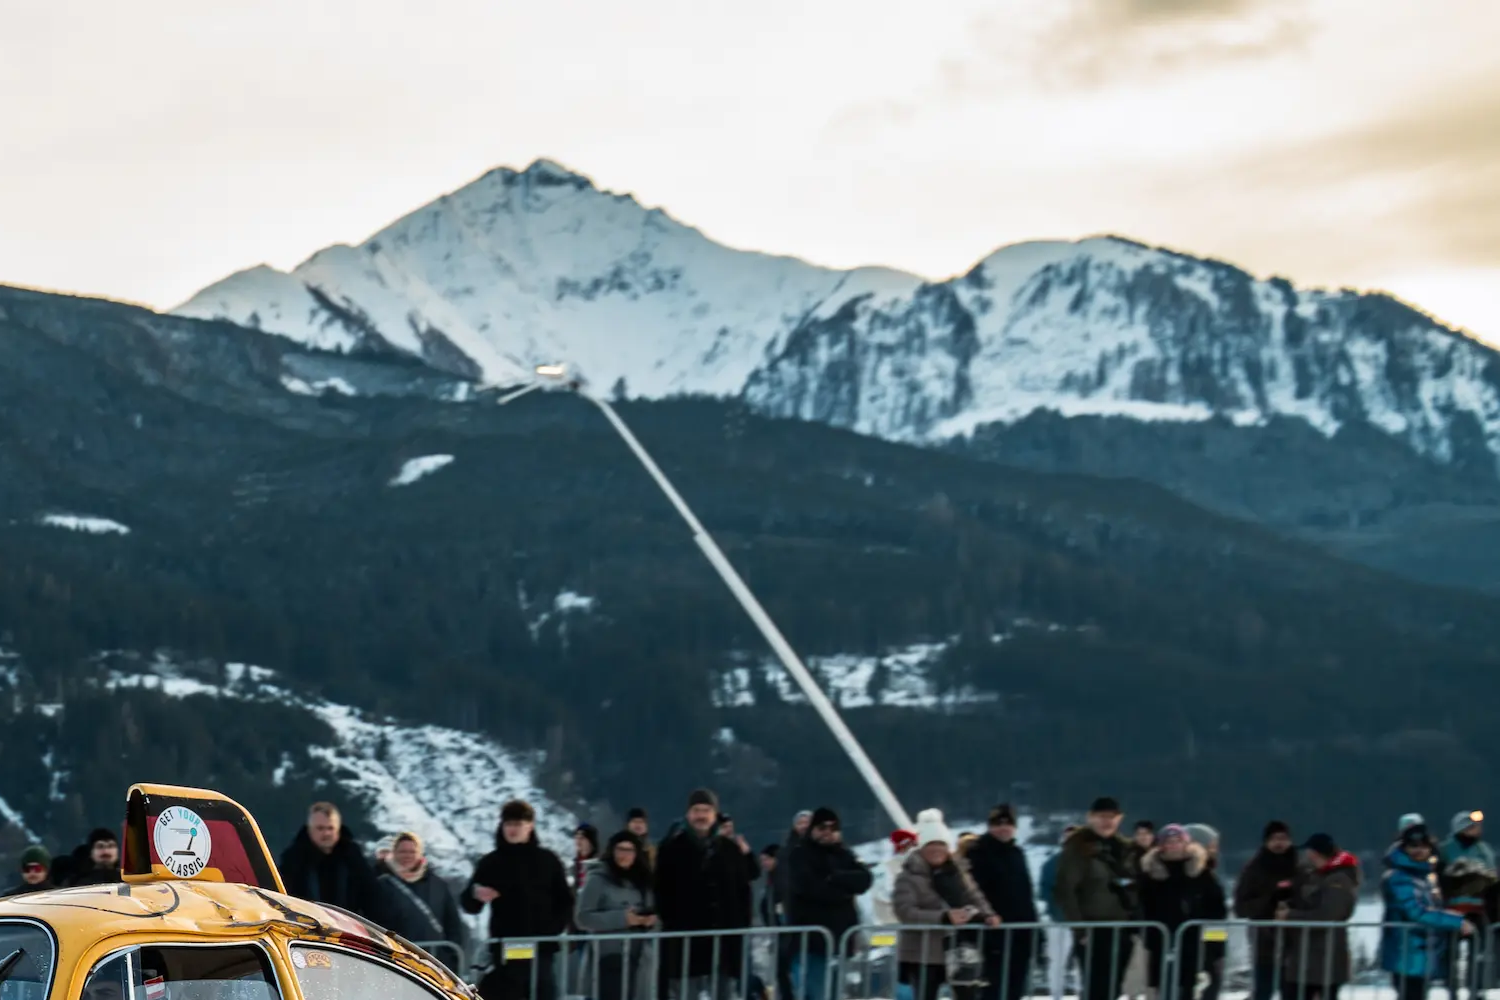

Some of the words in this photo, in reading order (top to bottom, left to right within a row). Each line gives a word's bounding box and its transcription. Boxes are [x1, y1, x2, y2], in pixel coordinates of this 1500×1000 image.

[159, 810, 174, 827] GET
[177, 808, 201, 827] YOUR
[164, 856, 204, 877] CLASSIC
